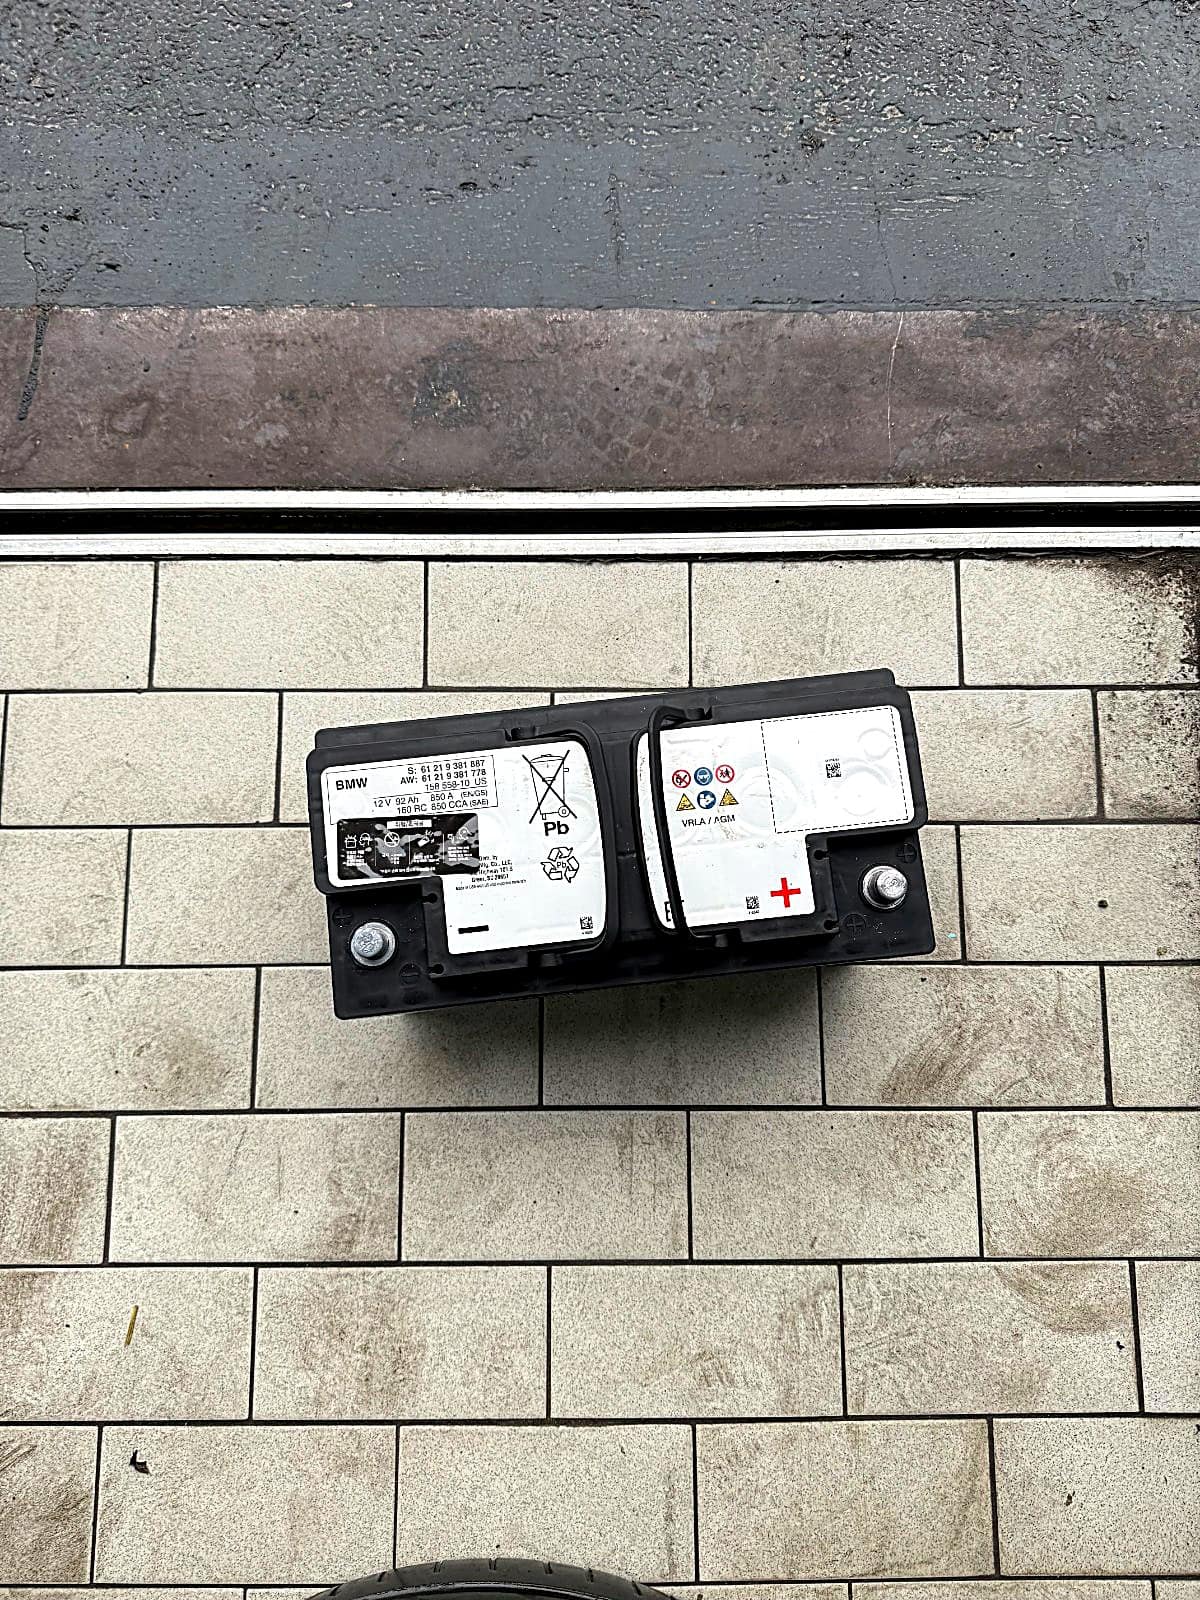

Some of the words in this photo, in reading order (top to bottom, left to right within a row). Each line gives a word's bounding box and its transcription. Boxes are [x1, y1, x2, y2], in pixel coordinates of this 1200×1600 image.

[336, 778, 367, 790] BMW
[400, 776, 418, 784] AW:
[430, 793, 445, 801] 850
[397, 806, 411, 814] 160
[431, 802, 446, 810] 850
[470, 799, 488, 807] (SAE)
[682, 818, 706, 827] VRLA
[714, 814, 735, 824] AGM
[544, 821, 569, 836] Pb
